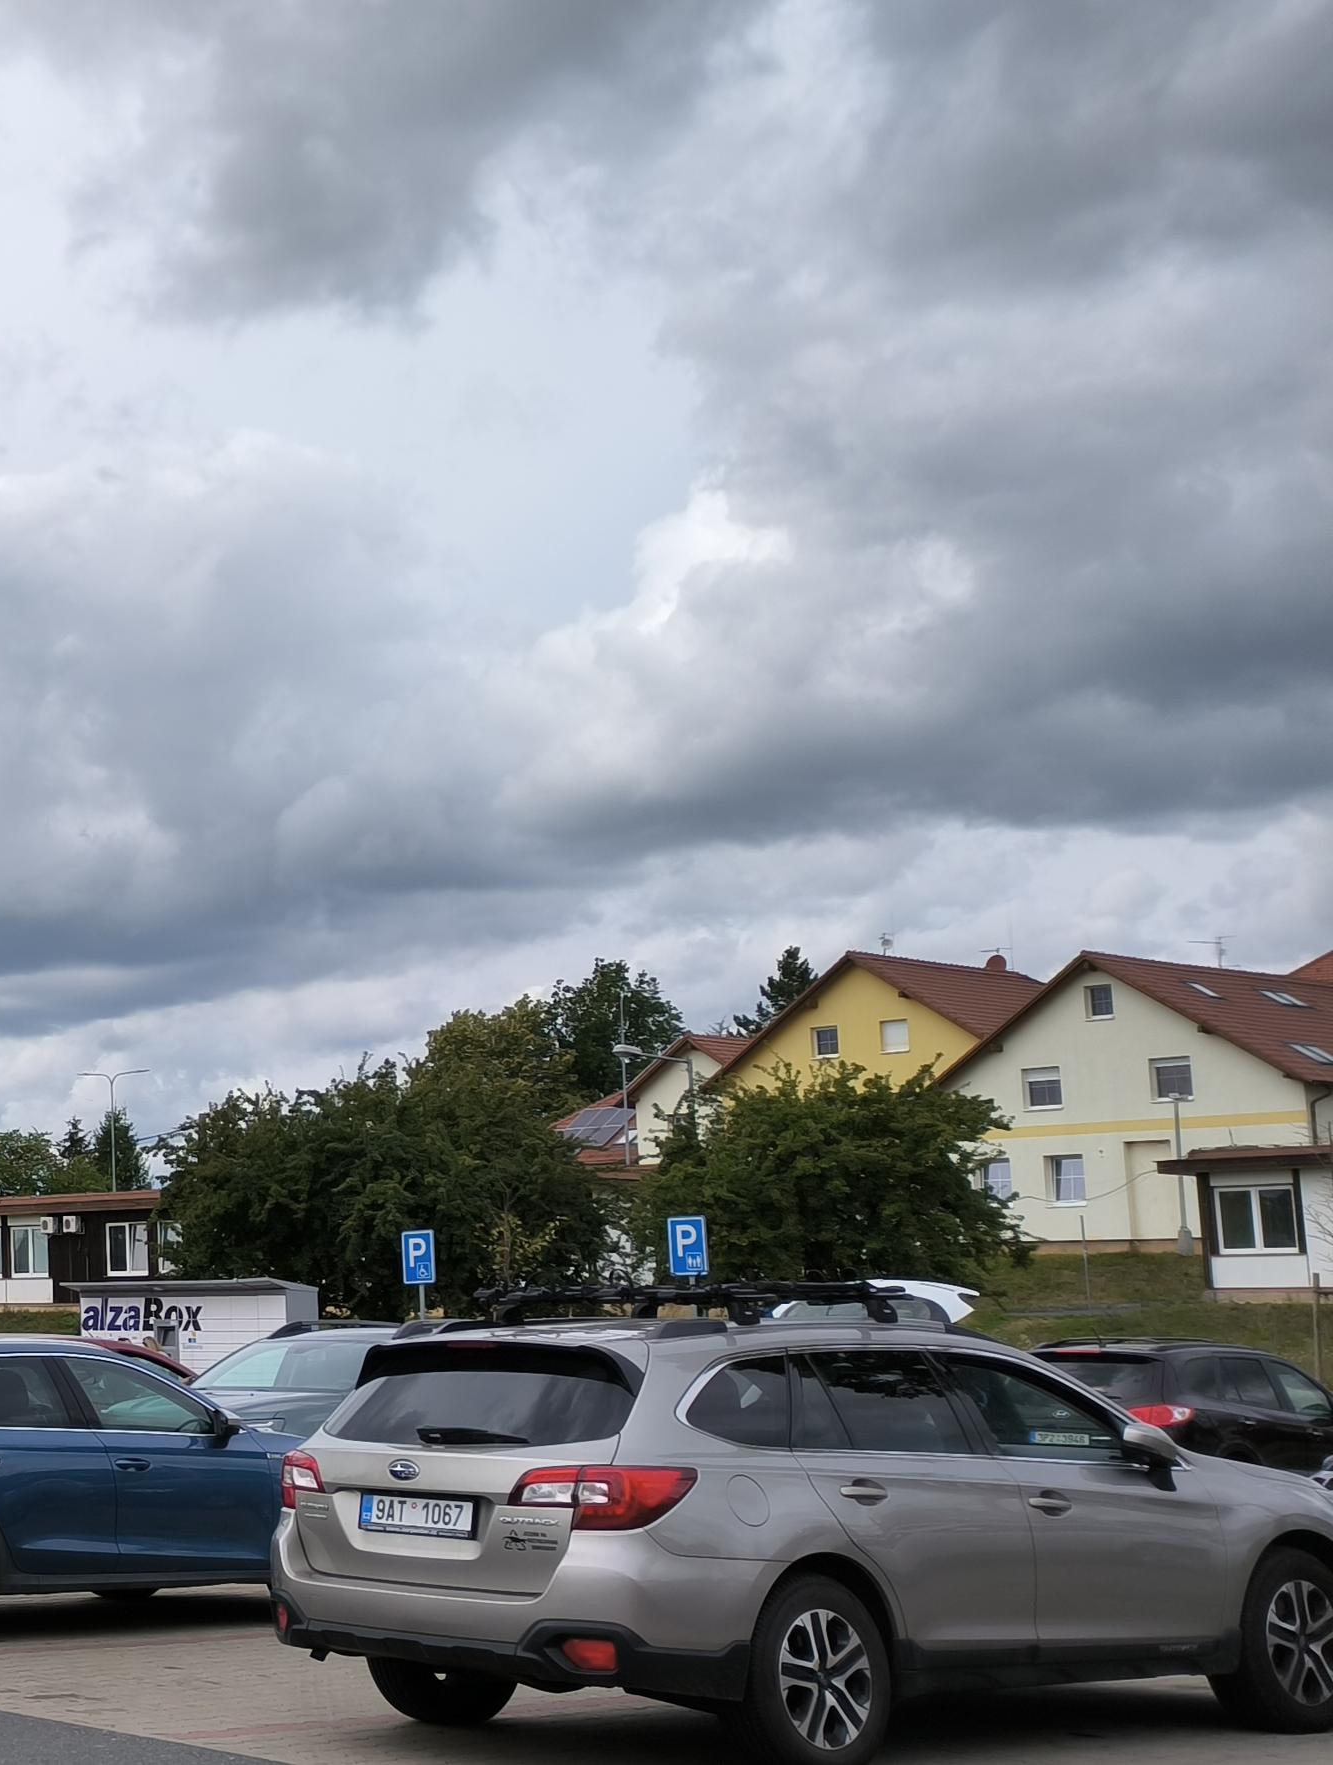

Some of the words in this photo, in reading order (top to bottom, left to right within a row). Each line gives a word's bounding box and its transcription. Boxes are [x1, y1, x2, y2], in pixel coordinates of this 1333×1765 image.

[409, 1238, 426, 1268] P
[676, 1224, 697, 1258] P
[82, 1297, 203, 1332] alzaBox
[376, 1498, 407, 1522] 9AT
[422, 1502, 464, 1527] 1067
